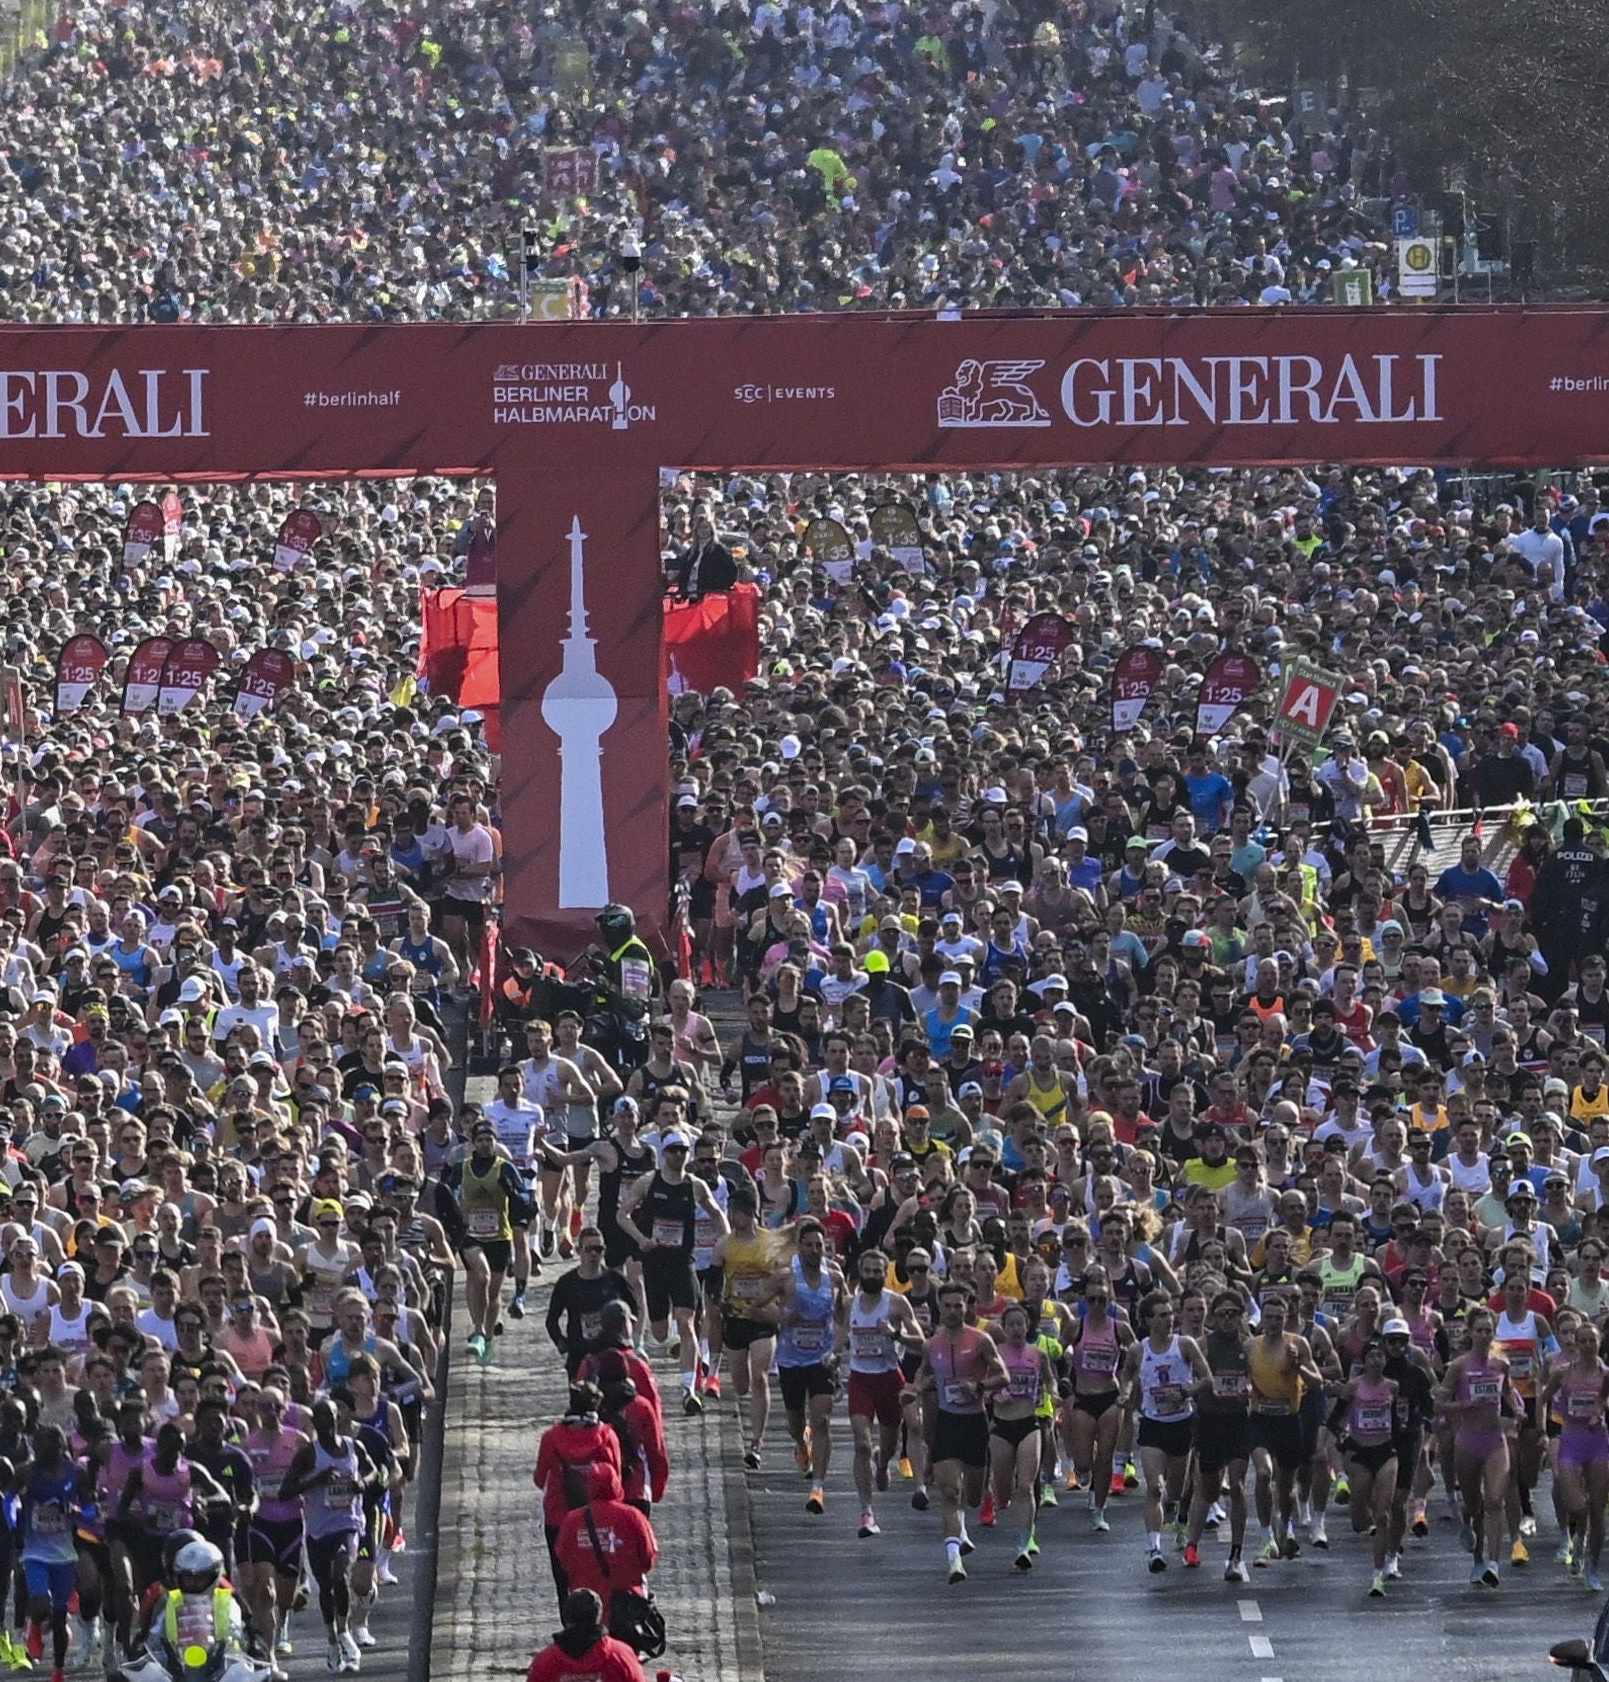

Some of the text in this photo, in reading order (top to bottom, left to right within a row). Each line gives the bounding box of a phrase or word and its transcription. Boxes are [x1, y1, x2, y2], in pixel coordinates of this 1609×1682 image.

[541, 293, 559, 318] C
[521, 364, 607, 381] GENERALI
[304, 390, 401, 407] #berlinhalf
[493, 386, 589, 403] BERLINER
[734, 385, 835, 402] SCC EVENTS
[1061, 353, 1443, 427] GENERALI
[493, 406, 656, 423] HALBMARATHON
[1019, 645, 1055, 661] 1:25
[62, 667, 94, 682] 1:25
[134, 668, 160, 684] 1:2
[166, 670, 202, 687] 1:25
[244, 675, 276, 698] 1:25
[1117, 680, 1150, 698] 1:25
[1205, 685, 1241, 703] 1:25
[1287, 685, 1319, 727] A
[1557, 851, 1594, 862] POLIZEI
